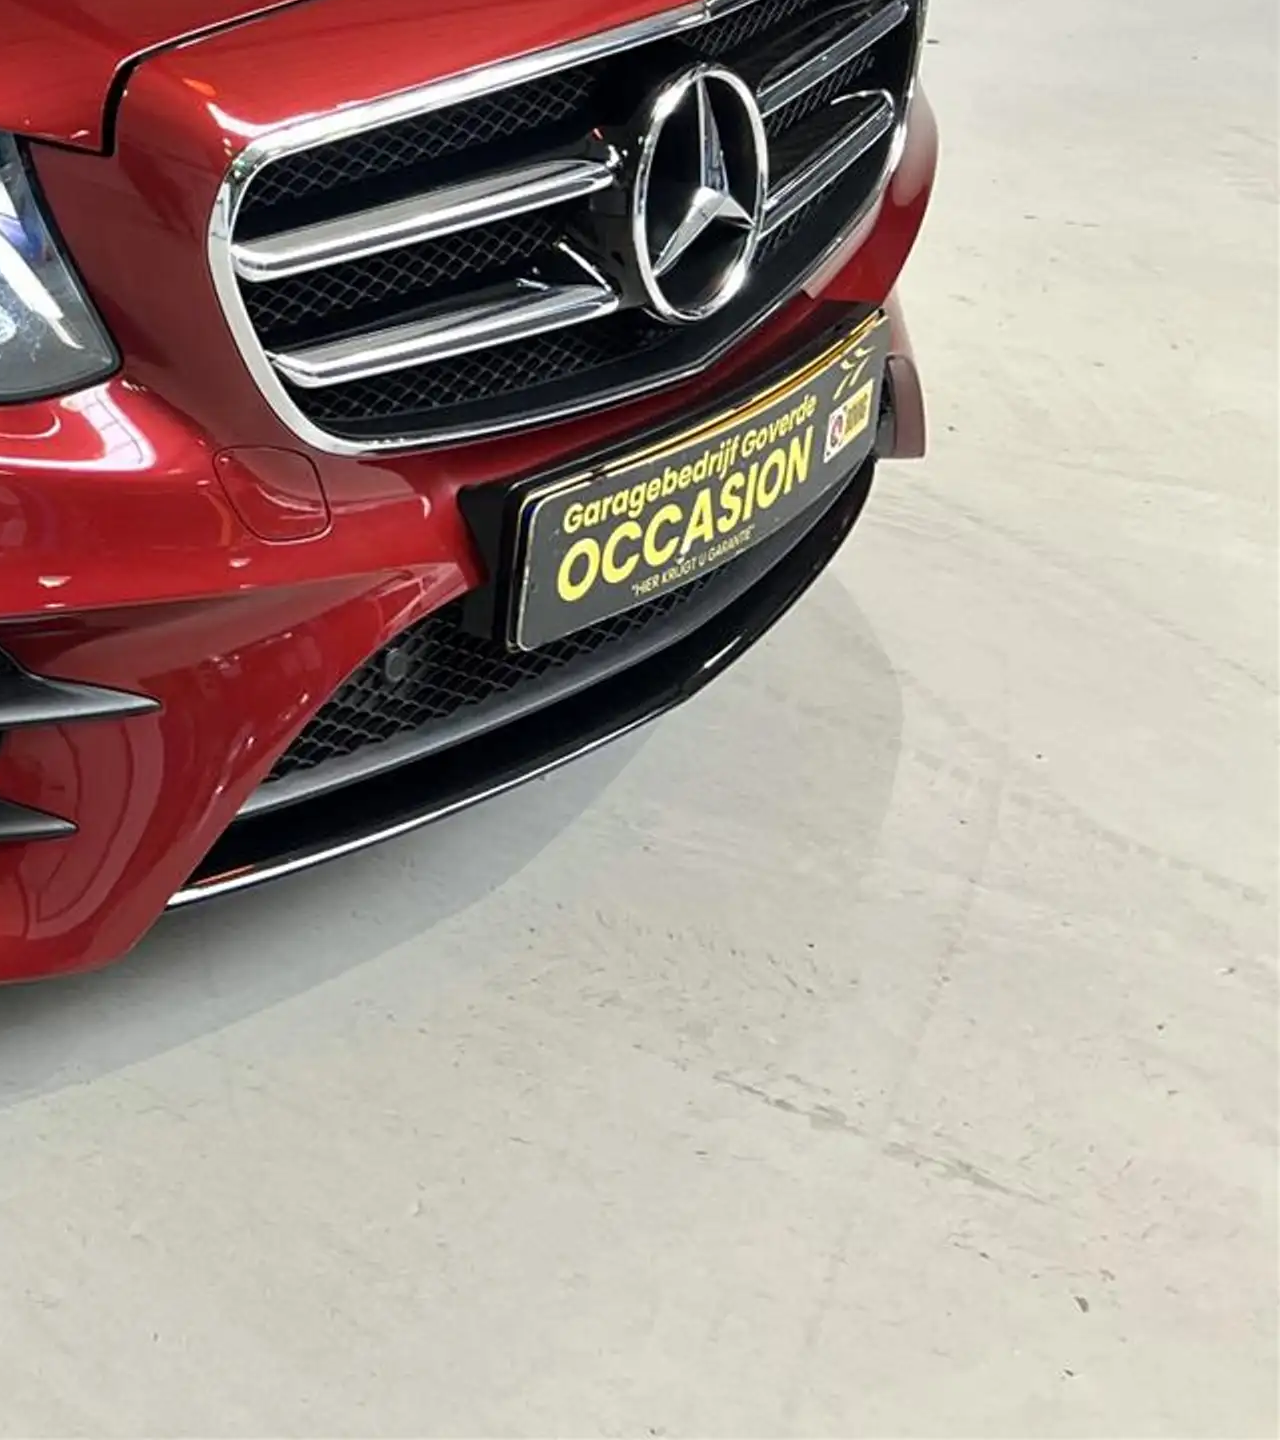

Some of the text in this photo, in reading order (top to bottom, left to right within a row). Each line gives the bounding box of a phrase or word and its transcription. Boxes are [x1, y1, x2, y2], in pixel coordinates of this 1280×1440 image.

[557, 426, 814, 601] OCCASION
[564, 436, 740, 533] Garagebedrijf
[741, 394, 817, 457] Goverde
